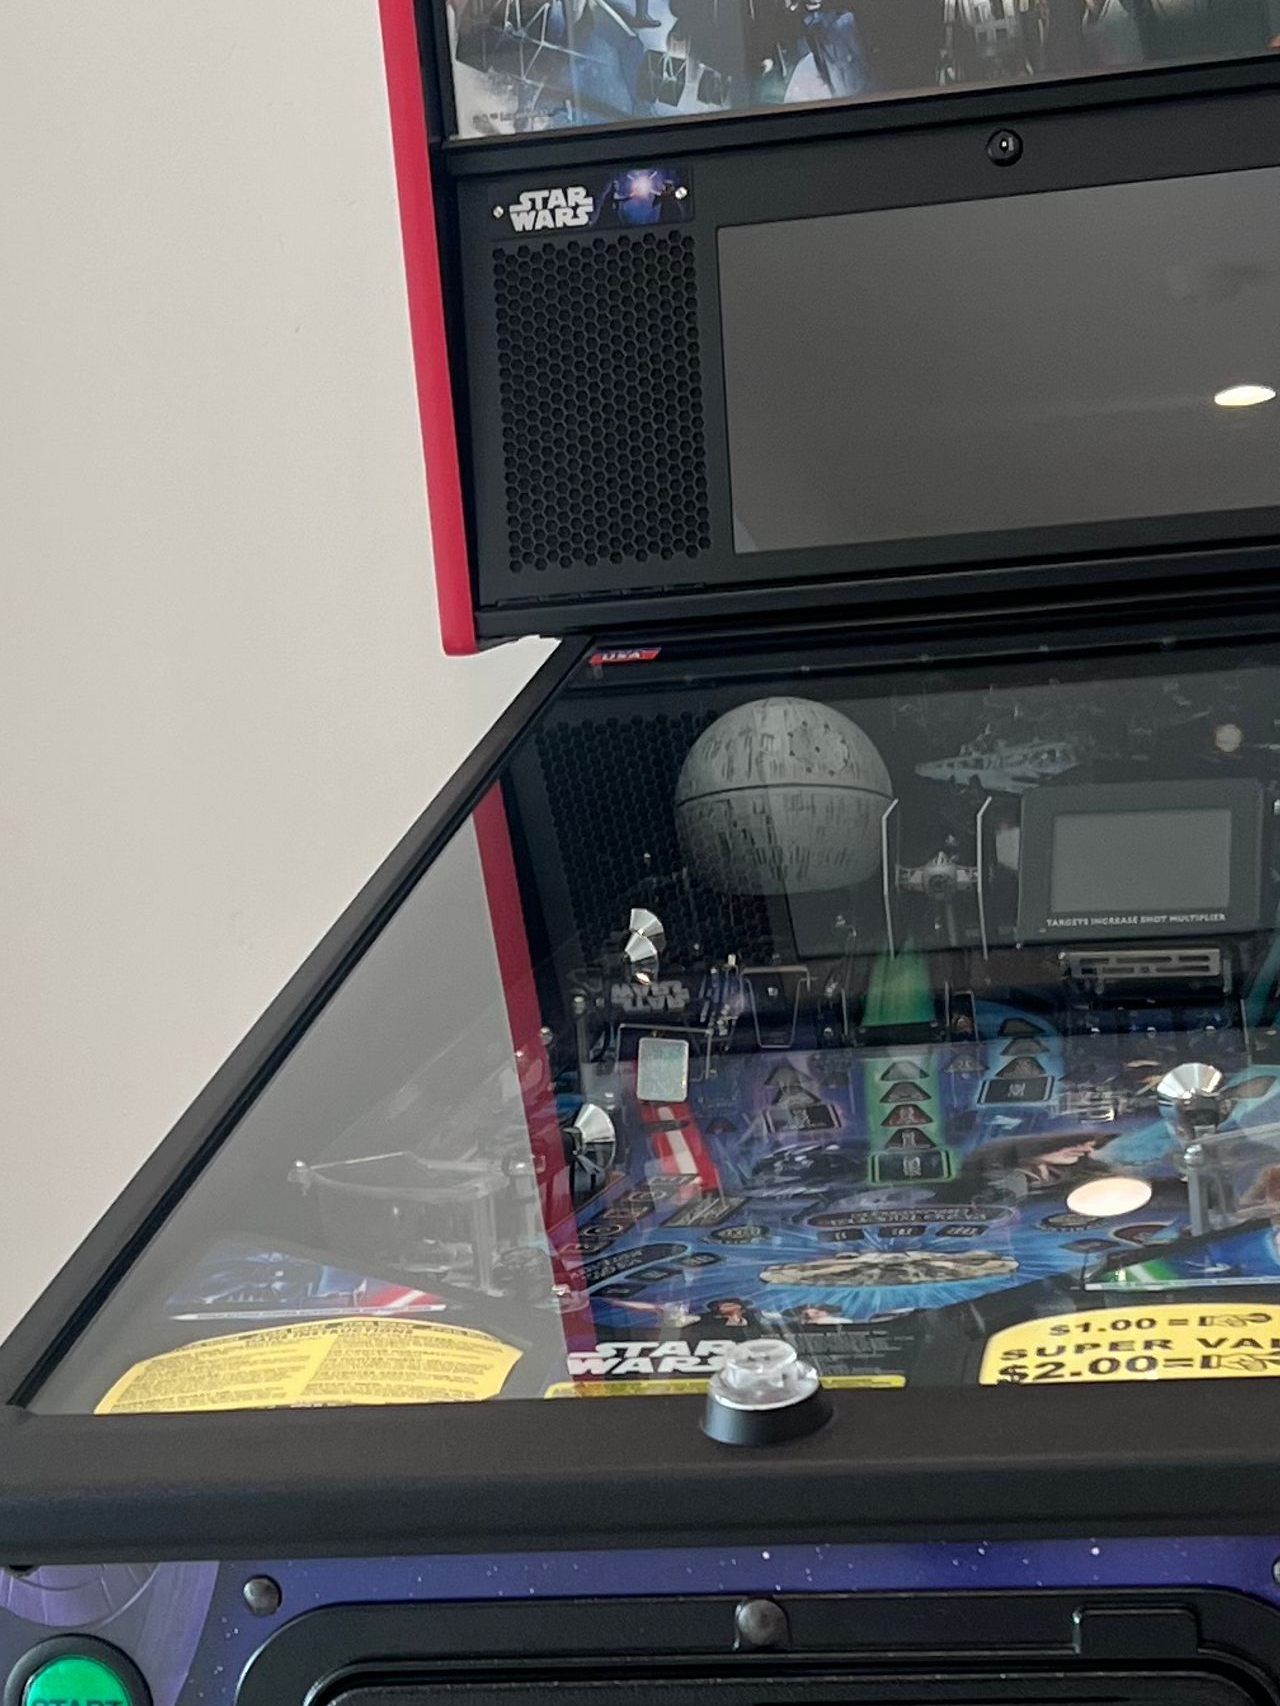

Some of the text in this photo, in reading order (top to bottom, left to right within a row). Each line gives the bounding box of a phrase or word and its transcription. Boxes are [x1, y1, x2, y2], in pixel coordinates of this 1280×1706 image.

[509, 186, 593, 212] STAR
[509, 204, 594, 232] WARS
[1046, 913, 1226, 927] TARGETS INCREASE SHOT MULTIPLIER
[1049, 1317, 1157, 1336] $1.00
[568, 1339, 737, 1359] STAR
[1000, 1339, 1174, 1361] SUPER
